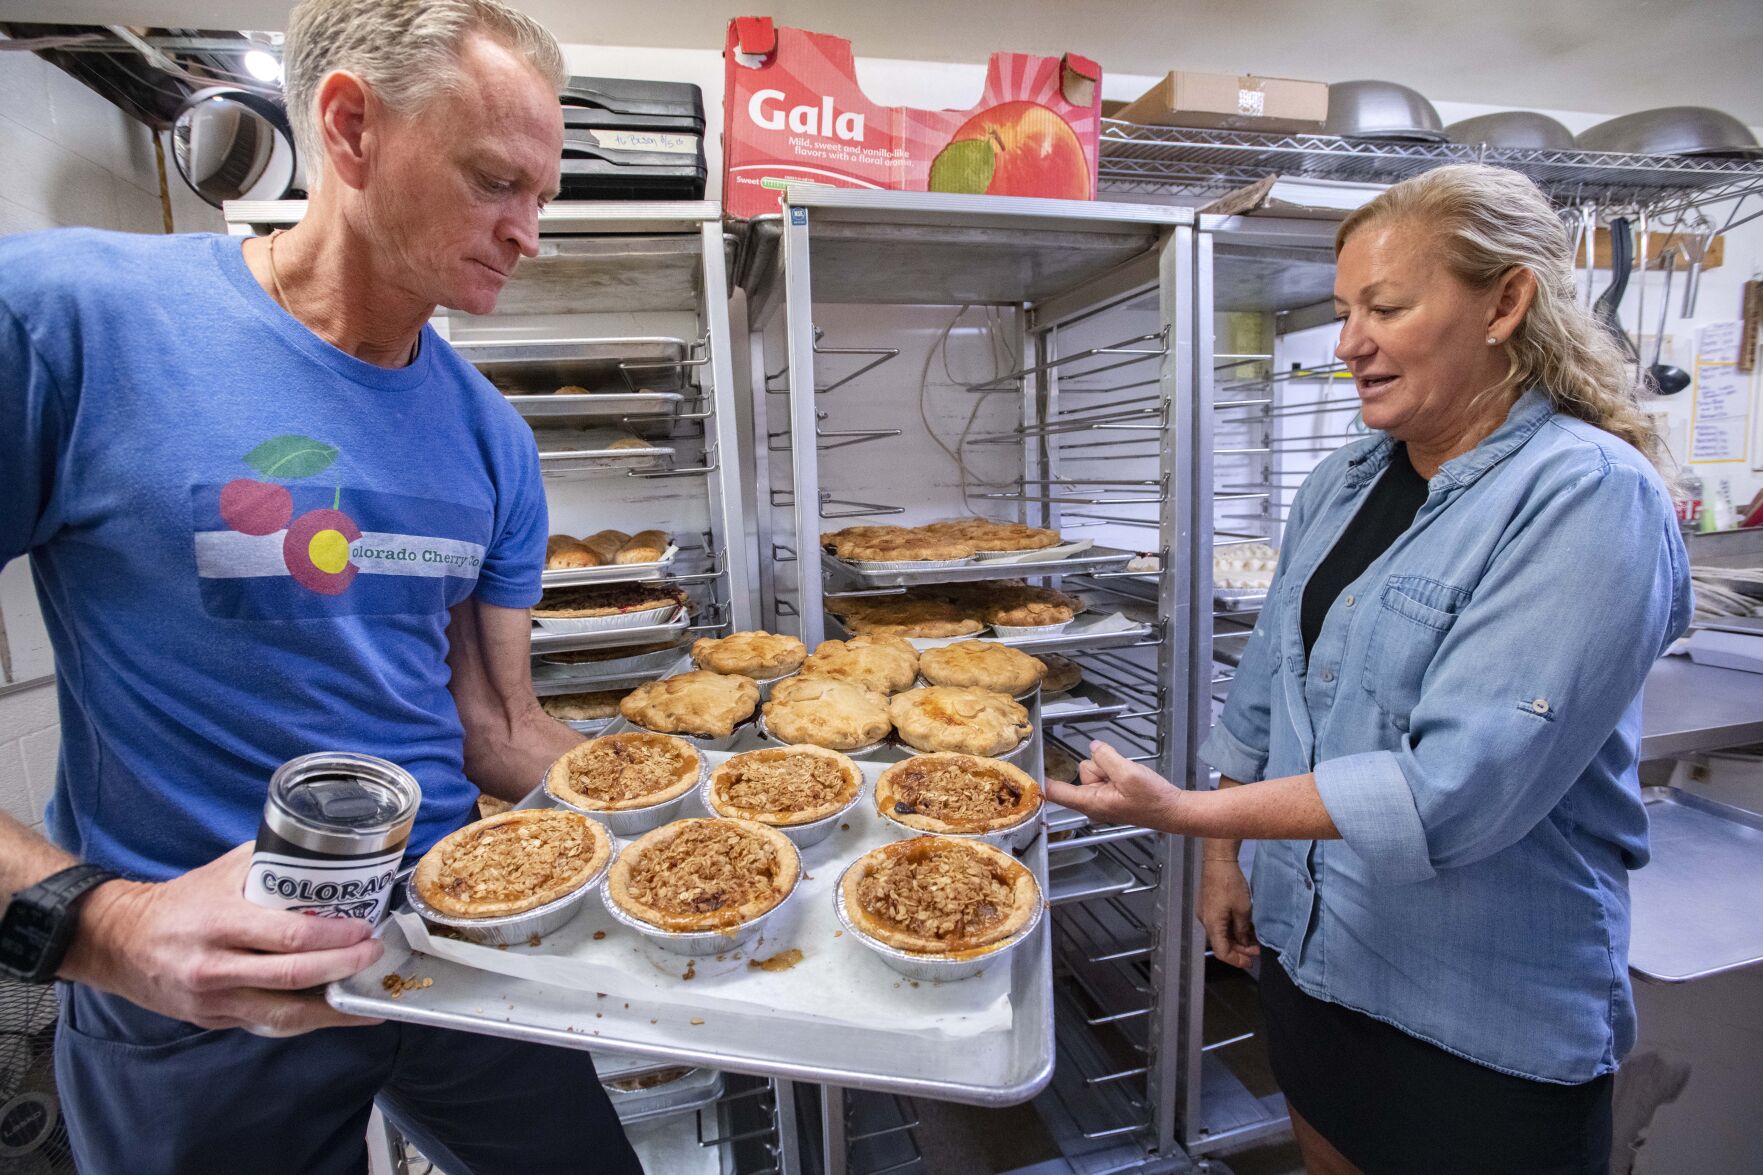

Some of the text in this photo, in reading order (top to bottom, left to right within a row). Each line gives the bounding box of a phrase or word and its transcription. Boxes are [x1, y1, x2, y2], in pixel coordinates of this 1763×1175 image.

[748, 89, 865, 141] Gala
[789, 137, 910, 158] Mild, sweet and vanilla-like
[795, 147, 827, 159] flavors
[829, 151, 850, 161] with
[859, 155, 883, 166] floral
[736, 176, 760, 185] Sweet
[421, 550, 468, 568] Cherry
